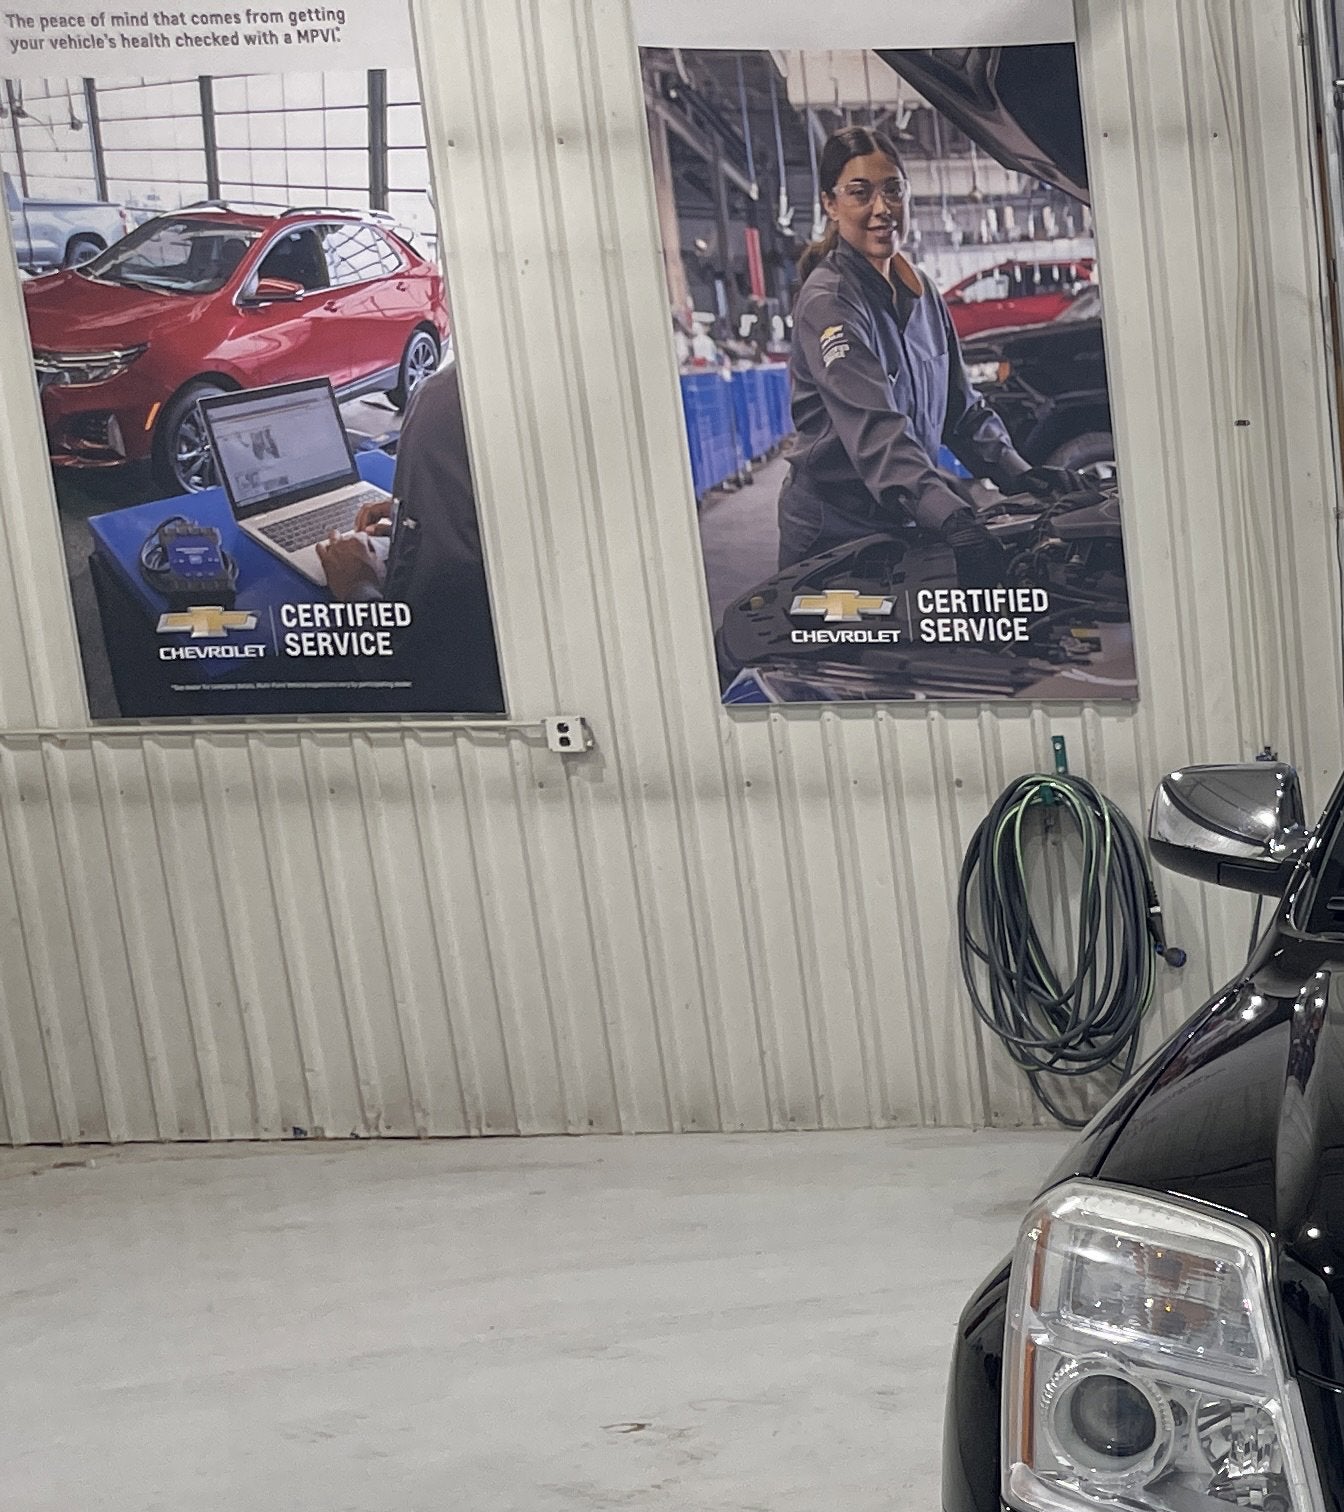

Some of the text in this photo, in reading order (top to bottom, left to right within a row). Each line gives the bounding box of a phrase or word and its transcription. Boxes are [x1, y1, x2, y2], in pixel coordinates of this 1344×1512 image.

[5, 7, 346, 31] The peace of mind that comes from getting
[10, 38, 45, 54] your
[50, 34, 117, 50] vehicle's
[121, 33, 171, 48] health
[175, 31, 240, 47] checked
[244, 30, 279, 45] with
[283, 33, 293, 44] a
[917, 588, 1049, 613] CERTIFIED
[280, 602, 412, 628] CERTIFIED
[791, 629, 901, 643] CHEVROLET
[920, 617, 1030, 642] SERVICE
[158, 644, 266, 660] CHEVROLET
[284, 631, 394, 656] SERVICE
